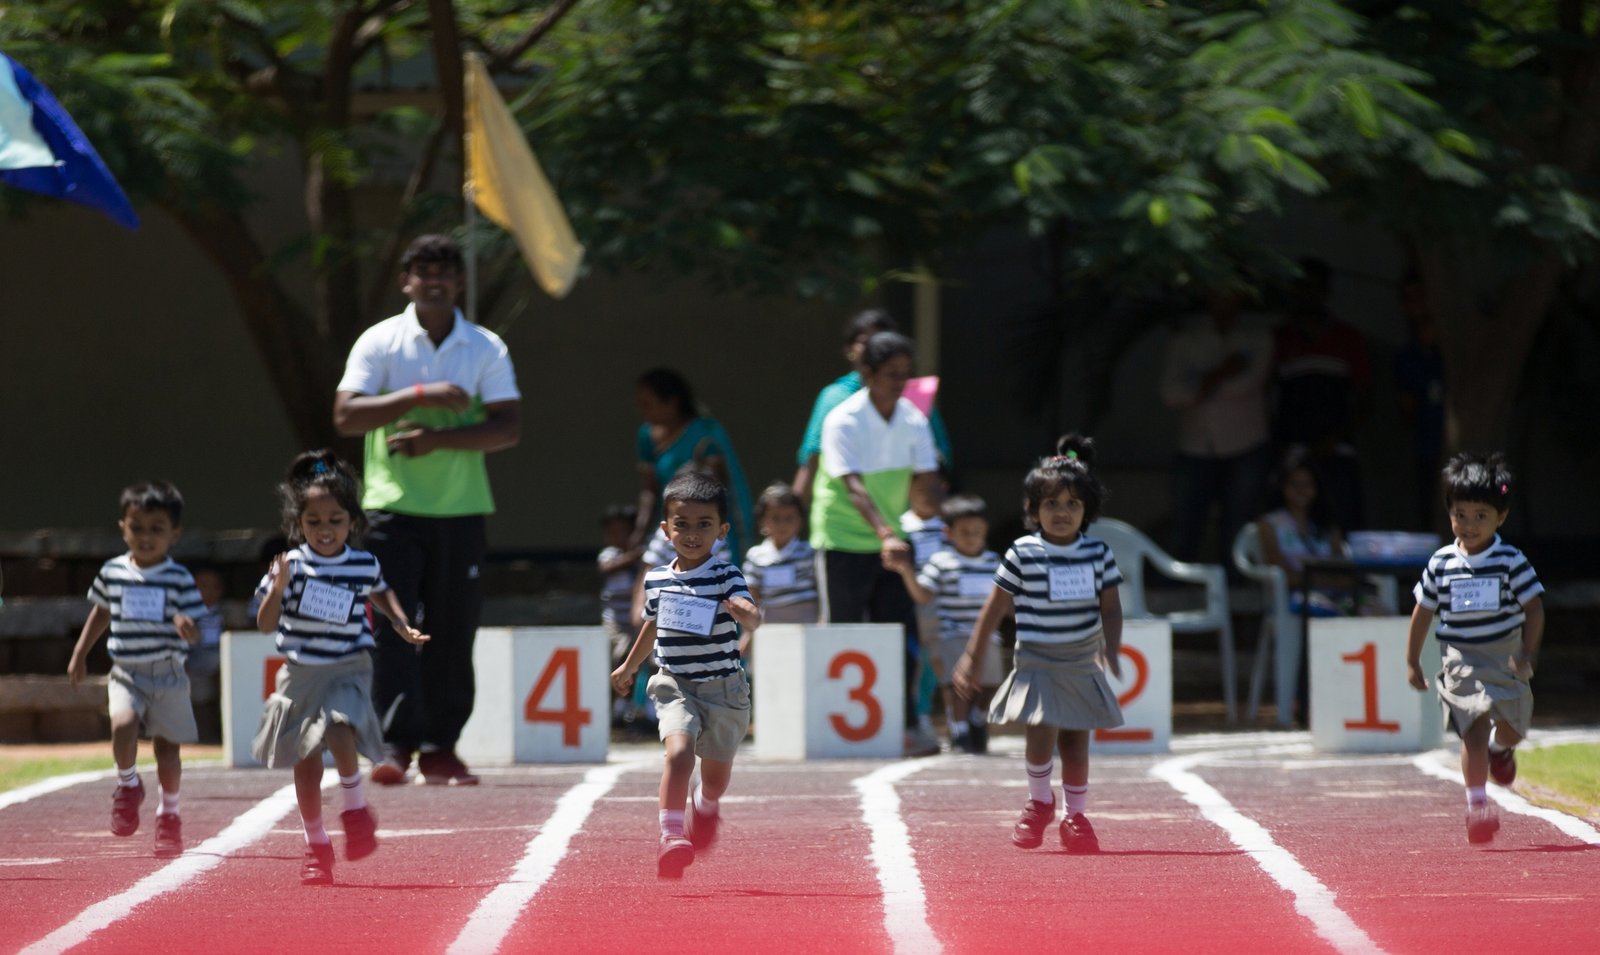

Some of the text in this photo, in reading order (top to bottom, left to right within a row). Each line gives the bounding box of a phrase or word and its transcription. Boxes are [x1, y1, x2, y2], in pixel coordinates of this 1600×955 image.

[524, 646, 593, 749] 4
[826, 648, 885, 746] 3
[1340, 642, 1402, 733] 1
